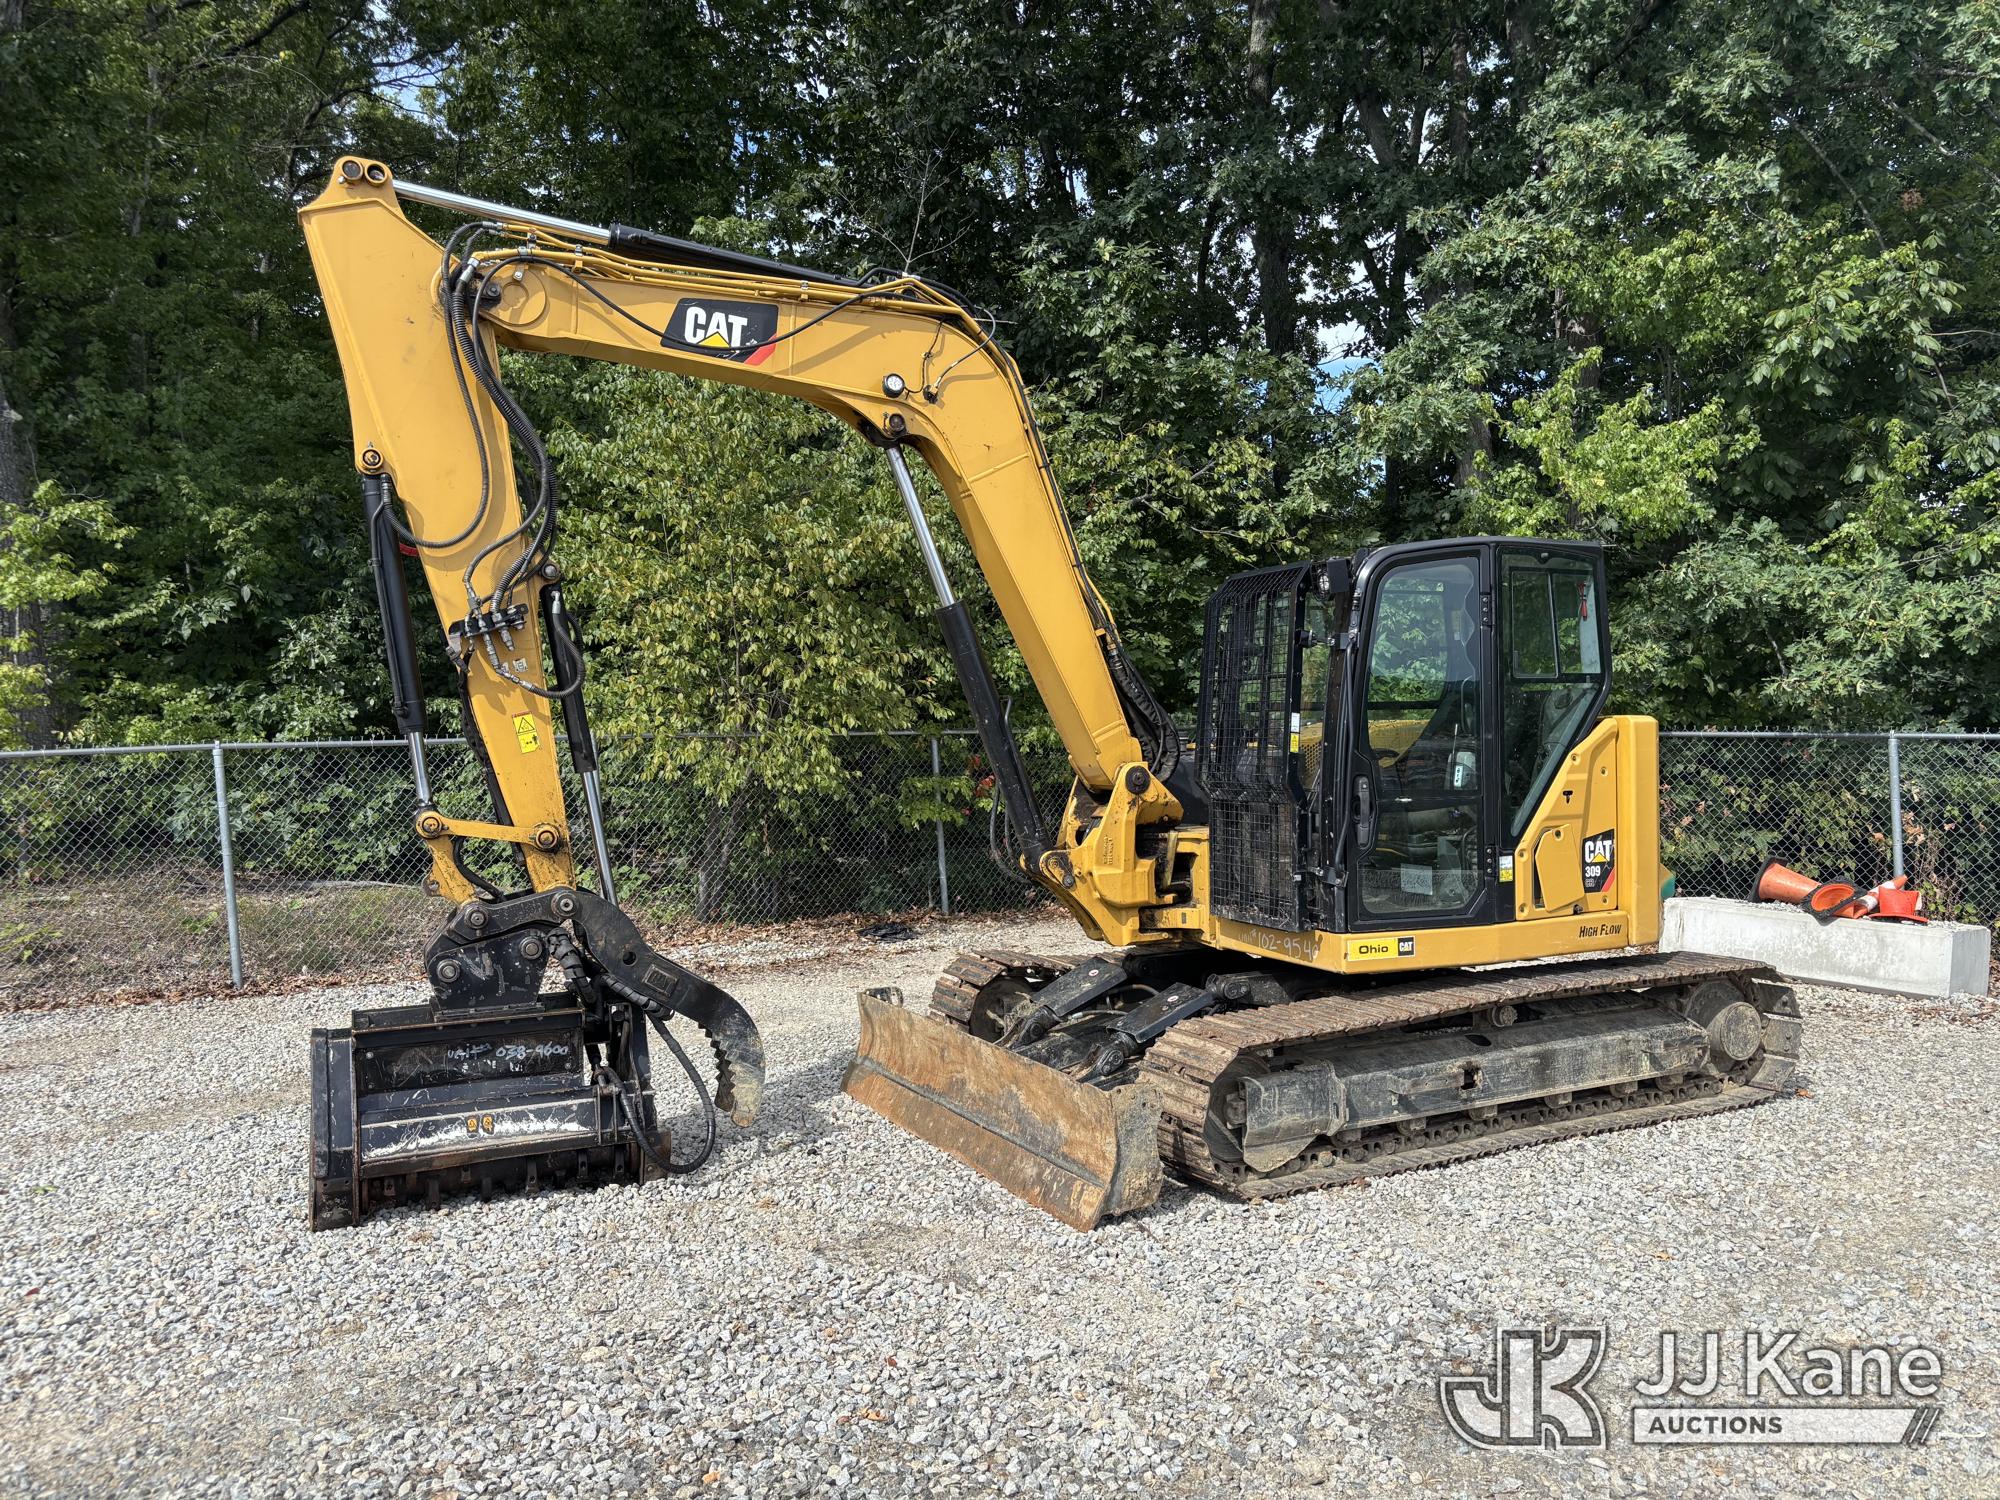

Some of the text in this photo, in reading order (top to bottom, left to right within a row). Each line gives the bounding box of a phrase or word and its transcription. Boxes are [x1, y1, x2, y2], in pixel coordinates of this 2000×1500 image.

[684, 306, 748, 348] CAT
[1584, 840, 1612, 863] CAT
[1585, 865, 1601, 877] 309
[1359, 941, 1413, 954] Ohio CAT
